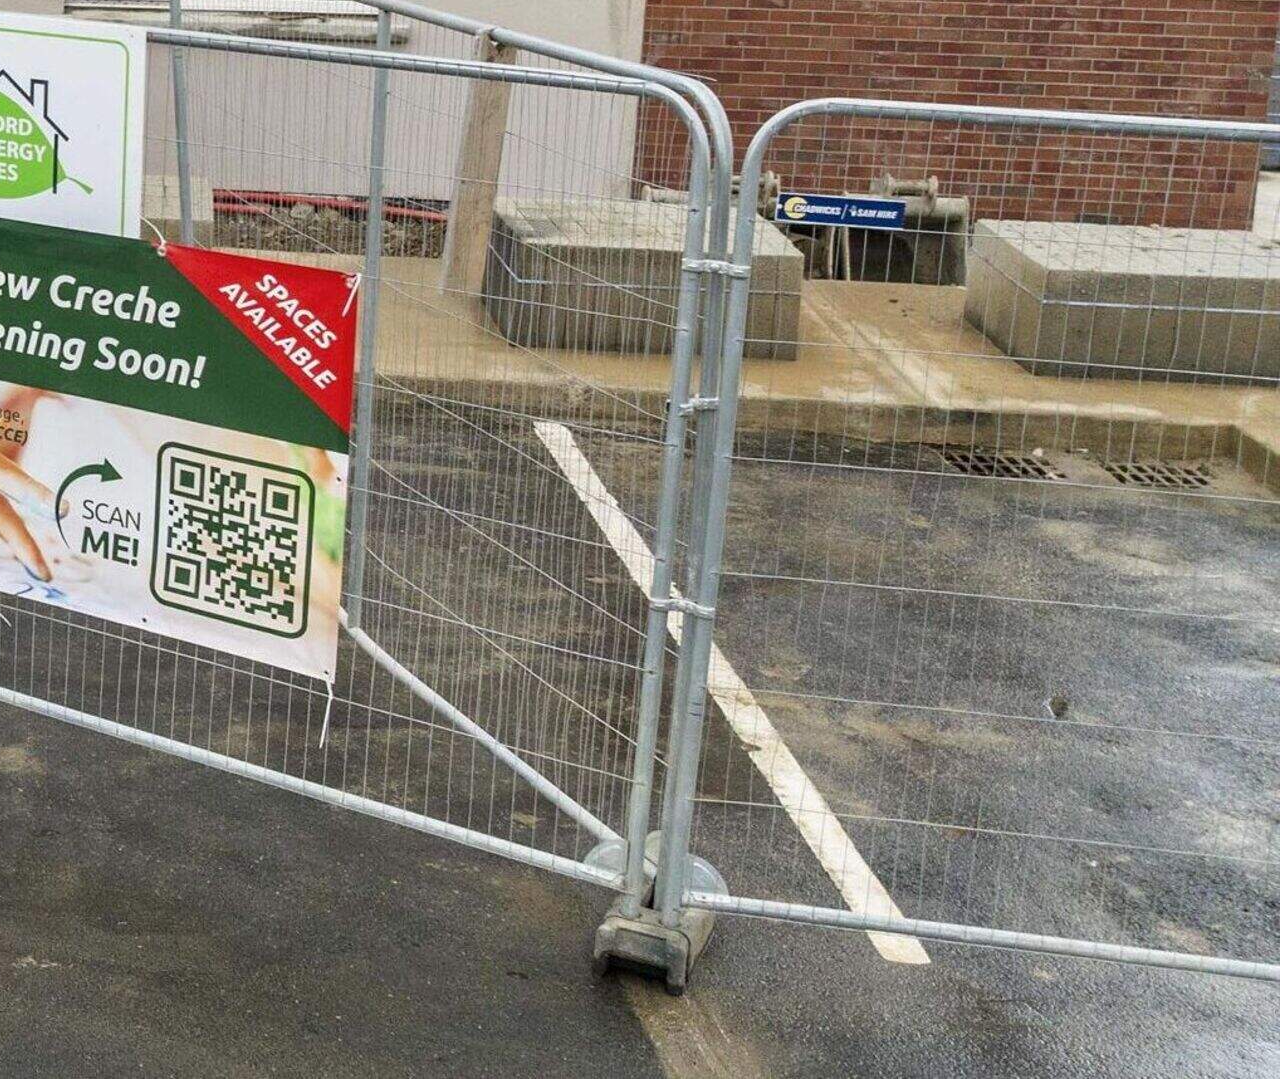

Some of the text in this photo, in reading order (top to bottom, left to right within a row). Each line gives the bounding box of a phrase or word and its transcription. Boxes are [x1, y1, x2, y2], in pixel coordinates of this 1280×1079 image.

[49, 275, 181, 329] Creche
[255, 274, 338, 349] SPACES
[93, 336, 207, 389] Soon!
[218, 283, 337, 390] AVAILABLE
[82, 499, 141, 532] SCAN
[81, 526, 139, 567] ME!
